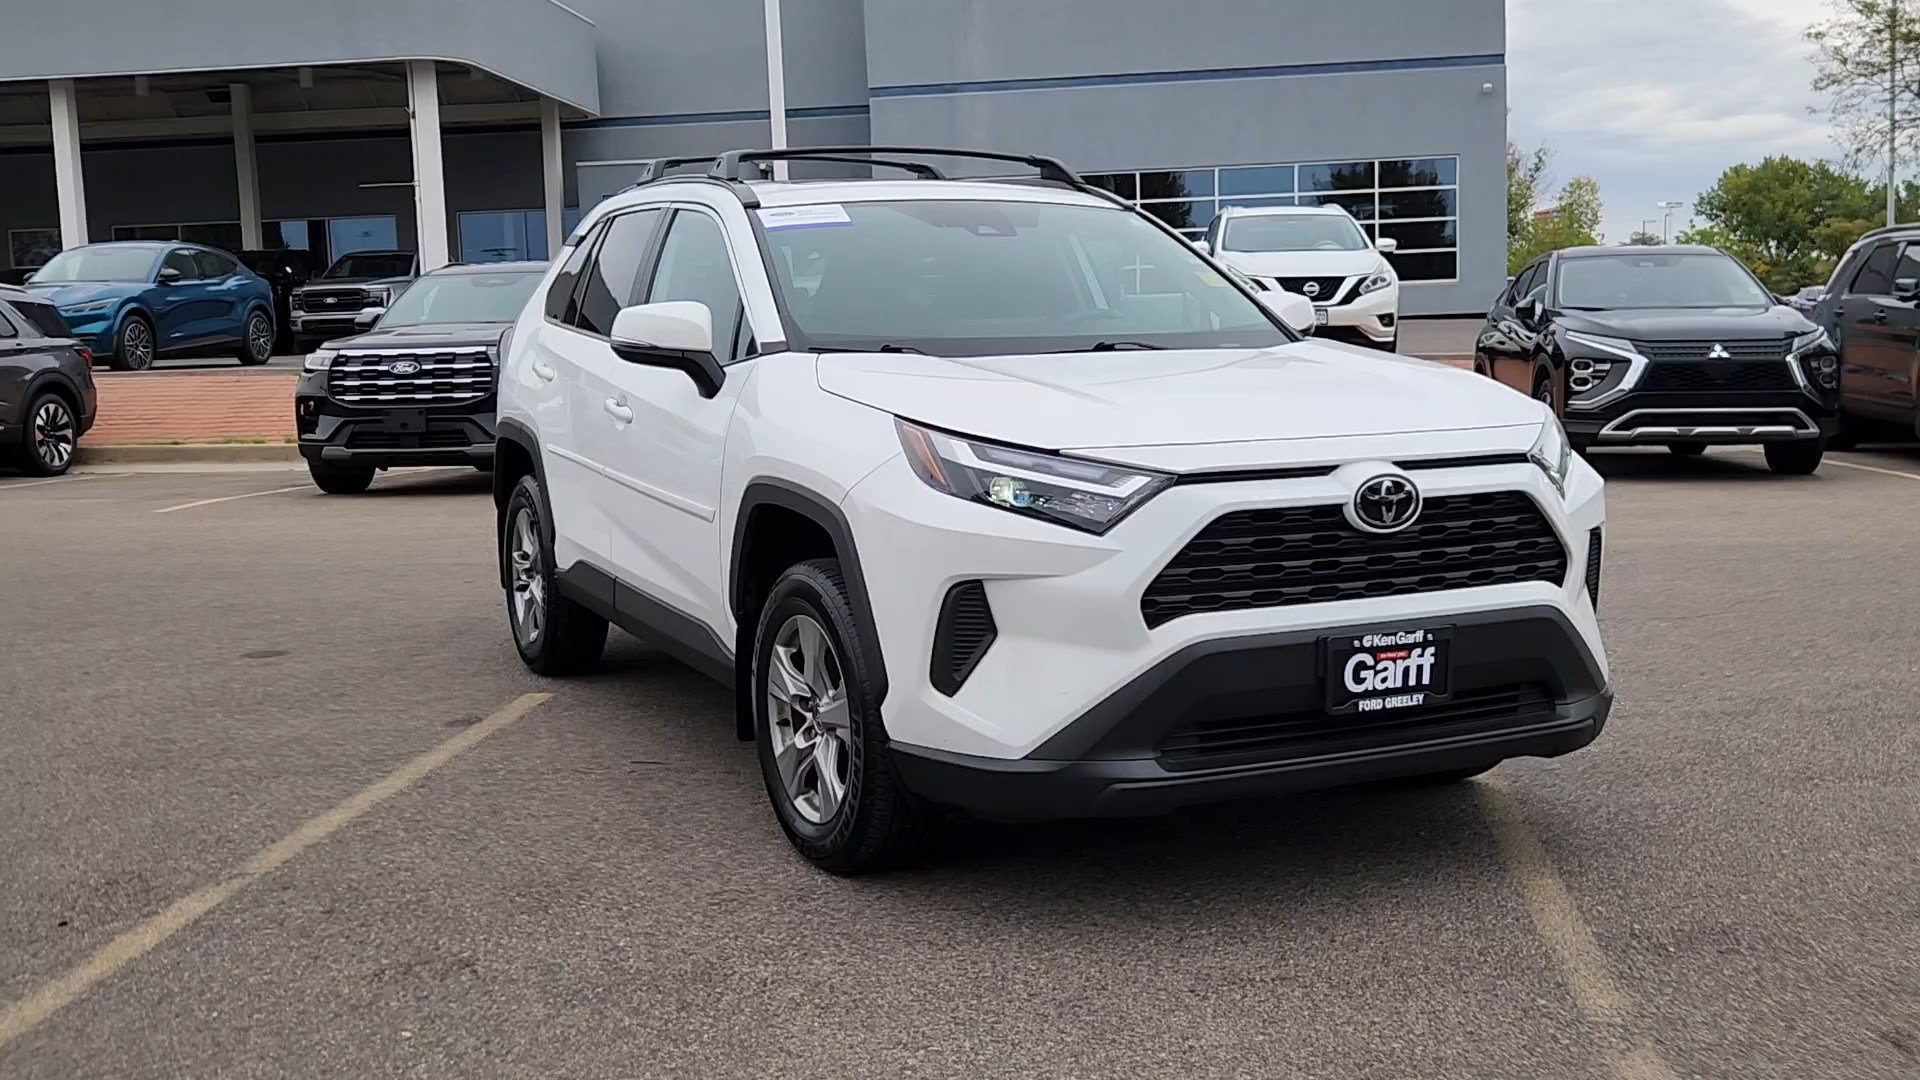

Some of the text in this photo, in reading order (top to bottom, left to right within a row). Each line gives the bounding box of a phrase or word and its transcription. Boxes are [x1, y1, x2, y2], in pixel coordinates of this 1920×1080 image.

[1373, 630, 1424, 647] Ken Garff
[1344, 647, 1435, 692] Garff
[1358, 694, 1424, 712] FORD GREELEY
